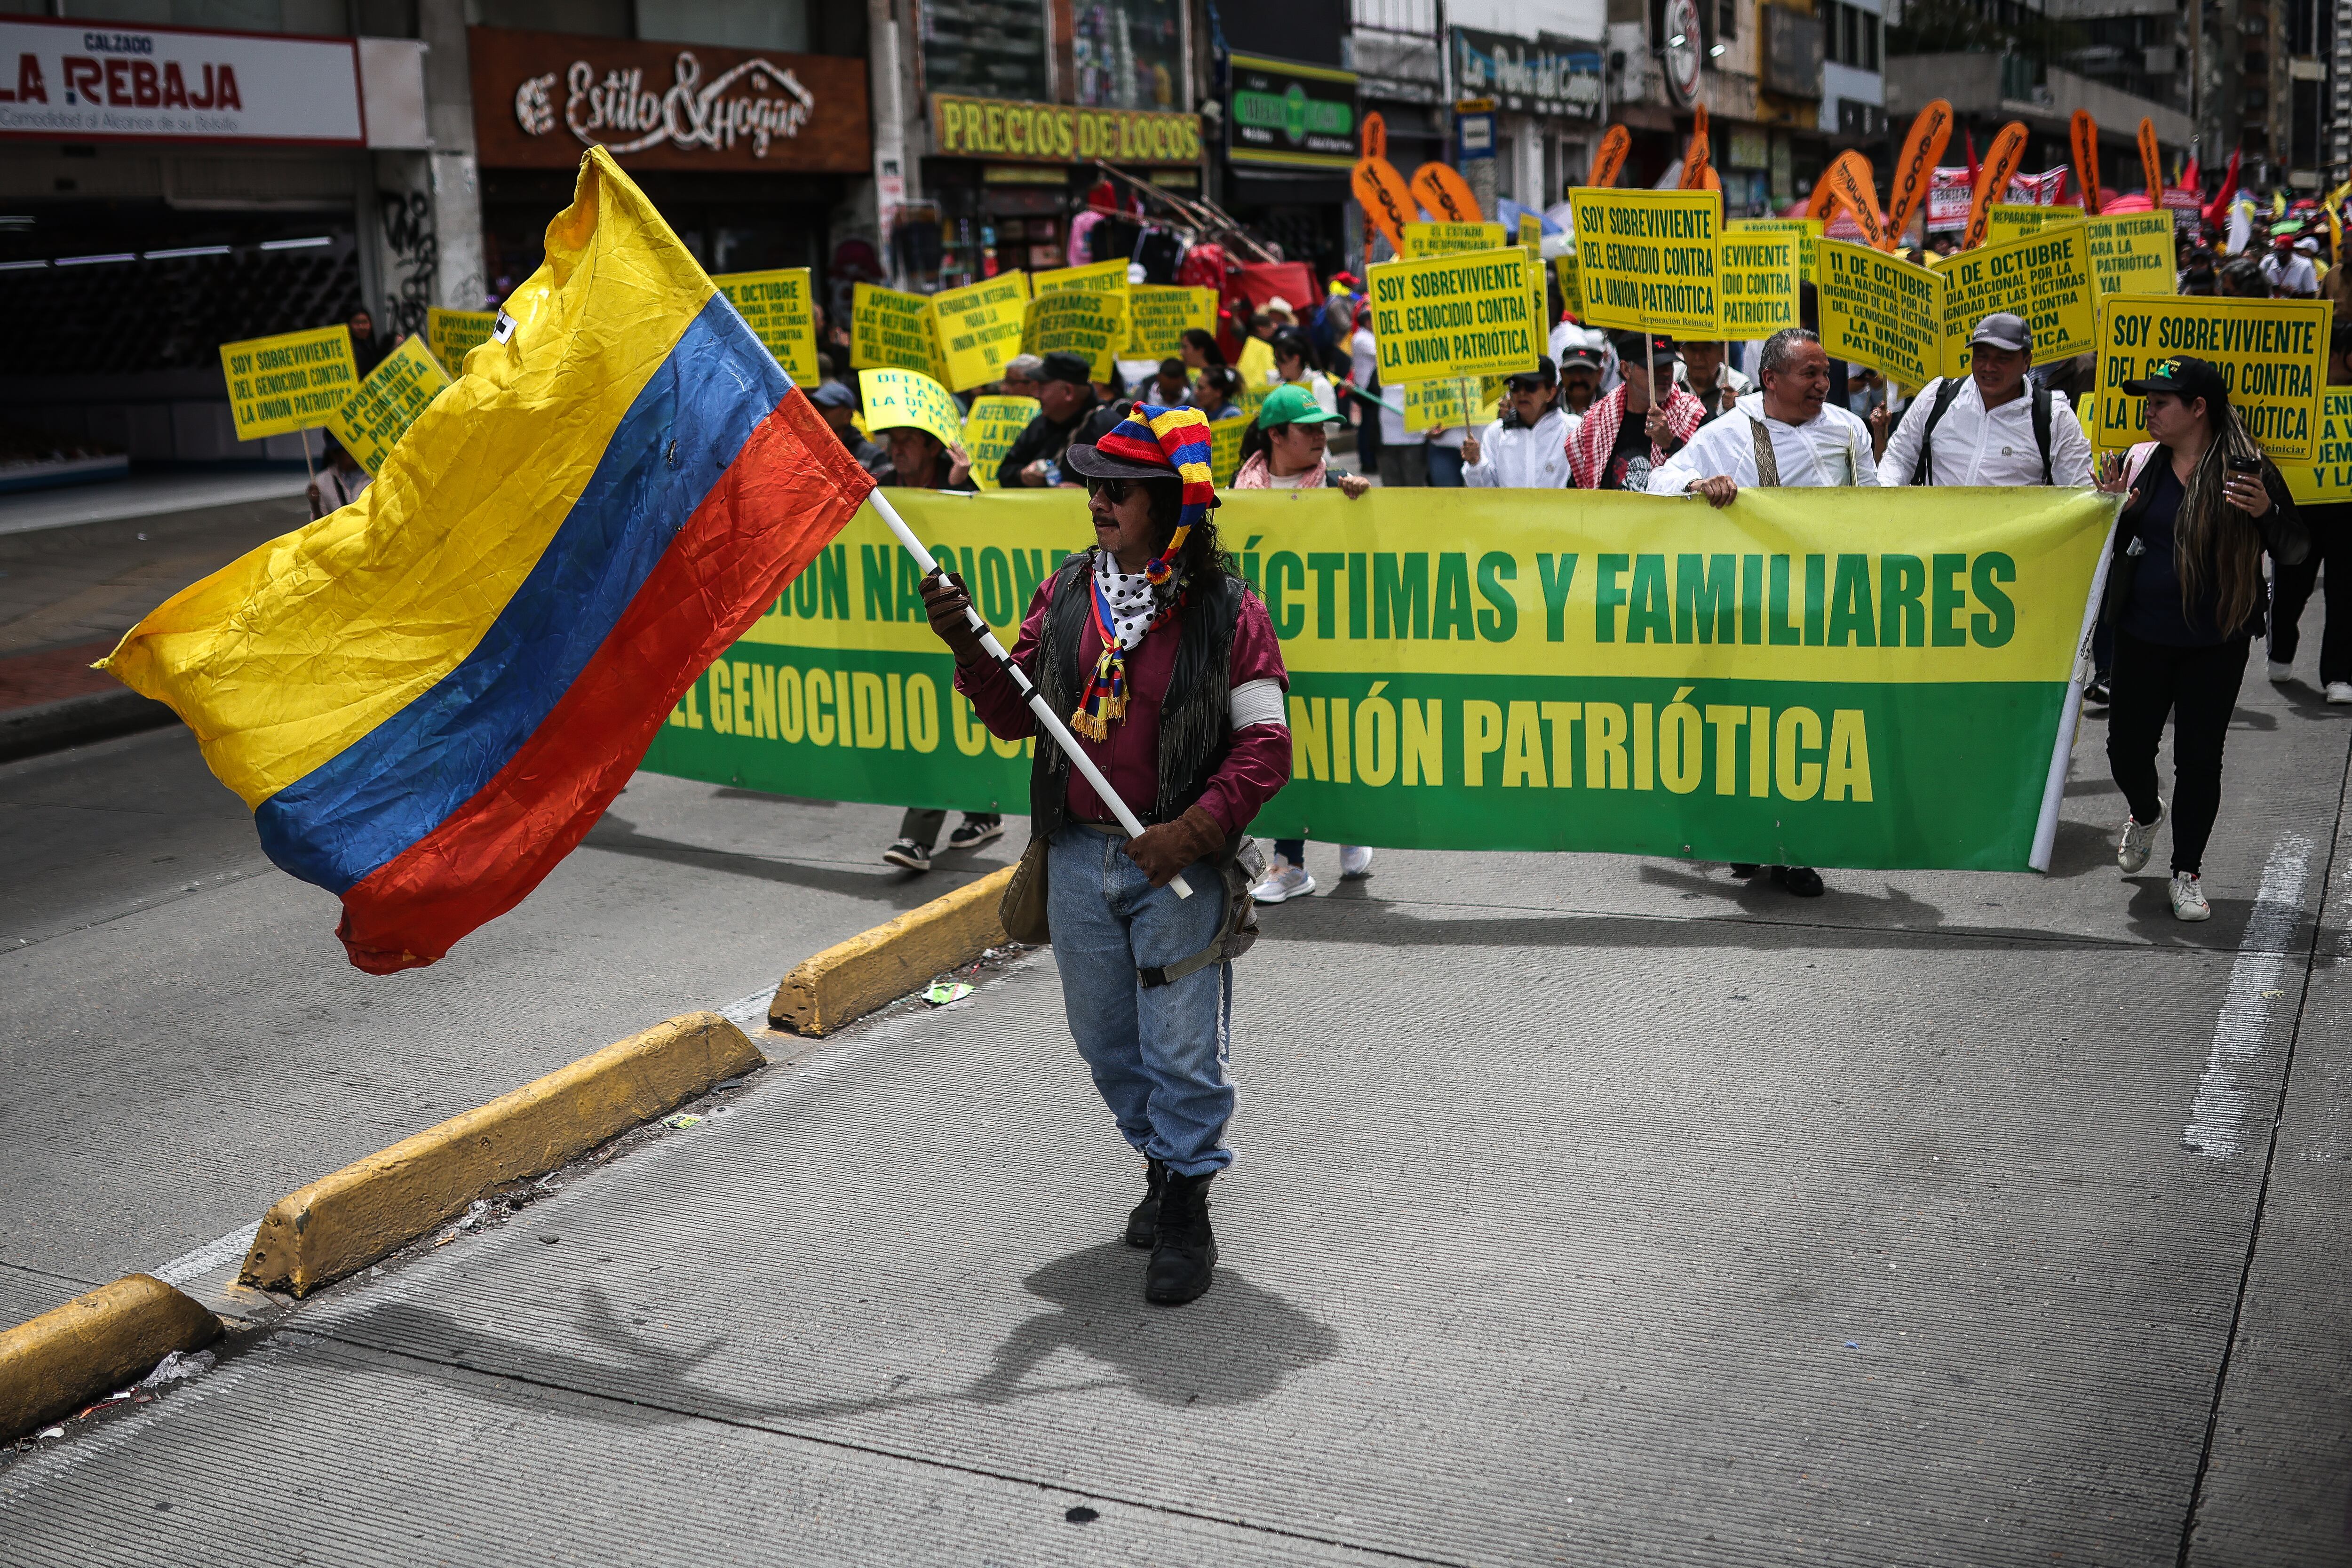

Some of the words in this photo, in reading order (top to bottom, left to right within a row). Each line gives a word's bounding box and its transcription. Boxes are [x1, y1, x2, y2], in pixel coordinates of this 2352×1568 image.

[84, 32, 153, 54] CALZADO
[0, 54, 48, 103] A
[62, 55, 242, 111] REBAJA
[942, 102, 1074, 157] PRECIOS
[1079, 110, 1119, 159] DE
[1120, 114, 1200, 159] LOCOS
[1581, 206, 1604, 234] SOY
[1609, 207, 1711, 239] SOBREVIVIENTE
[2116, 217, 2167, 237] INTEGRAL
[1583, 241, 1605, 269] DEL
[1606, 242, 1660, 275] GENOCIDIO
[1664, 247, 1714, 278] CONTRA
[1722, 245, 1790, 267] EVIVIENTE
[1943, 268, 1955, 292] 11
[1961, 260, 1984, 286] DE
[1990, 237, 2074, 278] OCTUBRE
[2090, 240, 2114, 257] ARA
[2118, 238, 2133, 255] LA
[2096, 254, 2163, 273] PATRIÓTICA
[740, 280, 799, 302] OCTUBRE
[1378, 275, 1406, 303] SOY
[1411, 263, 1523, 299] SOBREVIVIENTE
[1588, 276, 1604, 305] LA
[1605, 275, 1639, 310] UNIÓN
[1642, 279, 1714, 315] PATRIÓTICA
[1747, 274, 1791, 295] CONTRA
[1830, 251, 1843, 272] 11
[1850, 254, 1869, 278] DE
[1874, 263, 1933, 303] OCTUBRE
[1834, 271, 1852, 287] DÍA
[1855, 276, 1899, 303] NACIONAL
[1901, 293, 1917, 310] POR
[1921, 301, 1931, 317] LA
[1944, 298, 1985, 322] IGNIDAD
[1988, 293, 2003, 308] DE
[2007, 287, 2028, 304] LAS
[2031, 272, 2086, 298] VÍCTIMAS
[1946, 288, 1965, 306] DÍA
[1968, 273, 2026, 298] NACIONAL
[2030, 265, 2053, 282] POR
[2056, 261, 2073, 276] LA
[2100, 276, 2121, 293] YA!
[1379, 310, 1403, 335] DEL
[1406, 300, 1472, 332] GENOCIDIO
[1477, 294, 1527, 325] CONTRA
[1639, 314, 1681, 326] Corporación
[1682, 316, 1715, 328] Reiniciar
[1724, 297, 1791, 323] PATRIÓTICA
[1824, 283, 1868, 304] DIGNIDAD
[1871, 294, 1881, 310] DE
[1884, 300, 1899, 317] LAS
[1901, 308, 1939, 334] VÍCTIMAS
[1832, 299, 1850, 315] DEL
[1854, 304, 1898, 330] GENOCIDIO
[1900, 321, 1934, 348] CONTRA
[1946, 320, 1965, 338] DEL
[2032, 290, 2079, 313] CONTRA
[1383, 341, 1402, 368] LA
[1405, 333, 1450, 365] UNIÓN
[1454, 326, 1530, 360] PATRIÓTICA
[1843, 331, 1925, 376] PATRIÓTICA
[1849, 316, 1870, 336] LA
[1875, 324, 1919, 357] UNIÓN
[2114, 314, 2152, 347] SOY
[2158, 316, 2316, 355] SOBREVIVIENTE
[230, 354, 253, 375] SOY
[256, 339, 343, 372] SOBREVIVIENTE
[233, 379, 254, 400] DEL
[255, 370, 308, 397] GENOCIDIO
[310, 363, 350, 386] CONTRA
[340, 359, 410, 422] APOYAMOS
[2241, 361, 2312, 398] CONTRA
[238, 405, 255, 425] LA
[346, 421, 366, 444] LA
[363, 359, 428, 424] CONSULTA
[368, 387, 425, 444] POPULAR
[2105, 397, 2127, 430] LA
[2234, 398, 2307, 440] IÓTICA
[2313, 467, 2326, 488] Y
[1242, 534, 1518, 644] ÍCTIMAS
[1535, 553, 1579, 643] Y
[1595, 550, 2017, 649] FAMILIARES
[708, 659, 939, 754] GENOCIDIO
[1288, 681, 1453, 788] NIÓN
[1463, 686, 1874, 802] PATRIÓTICA
